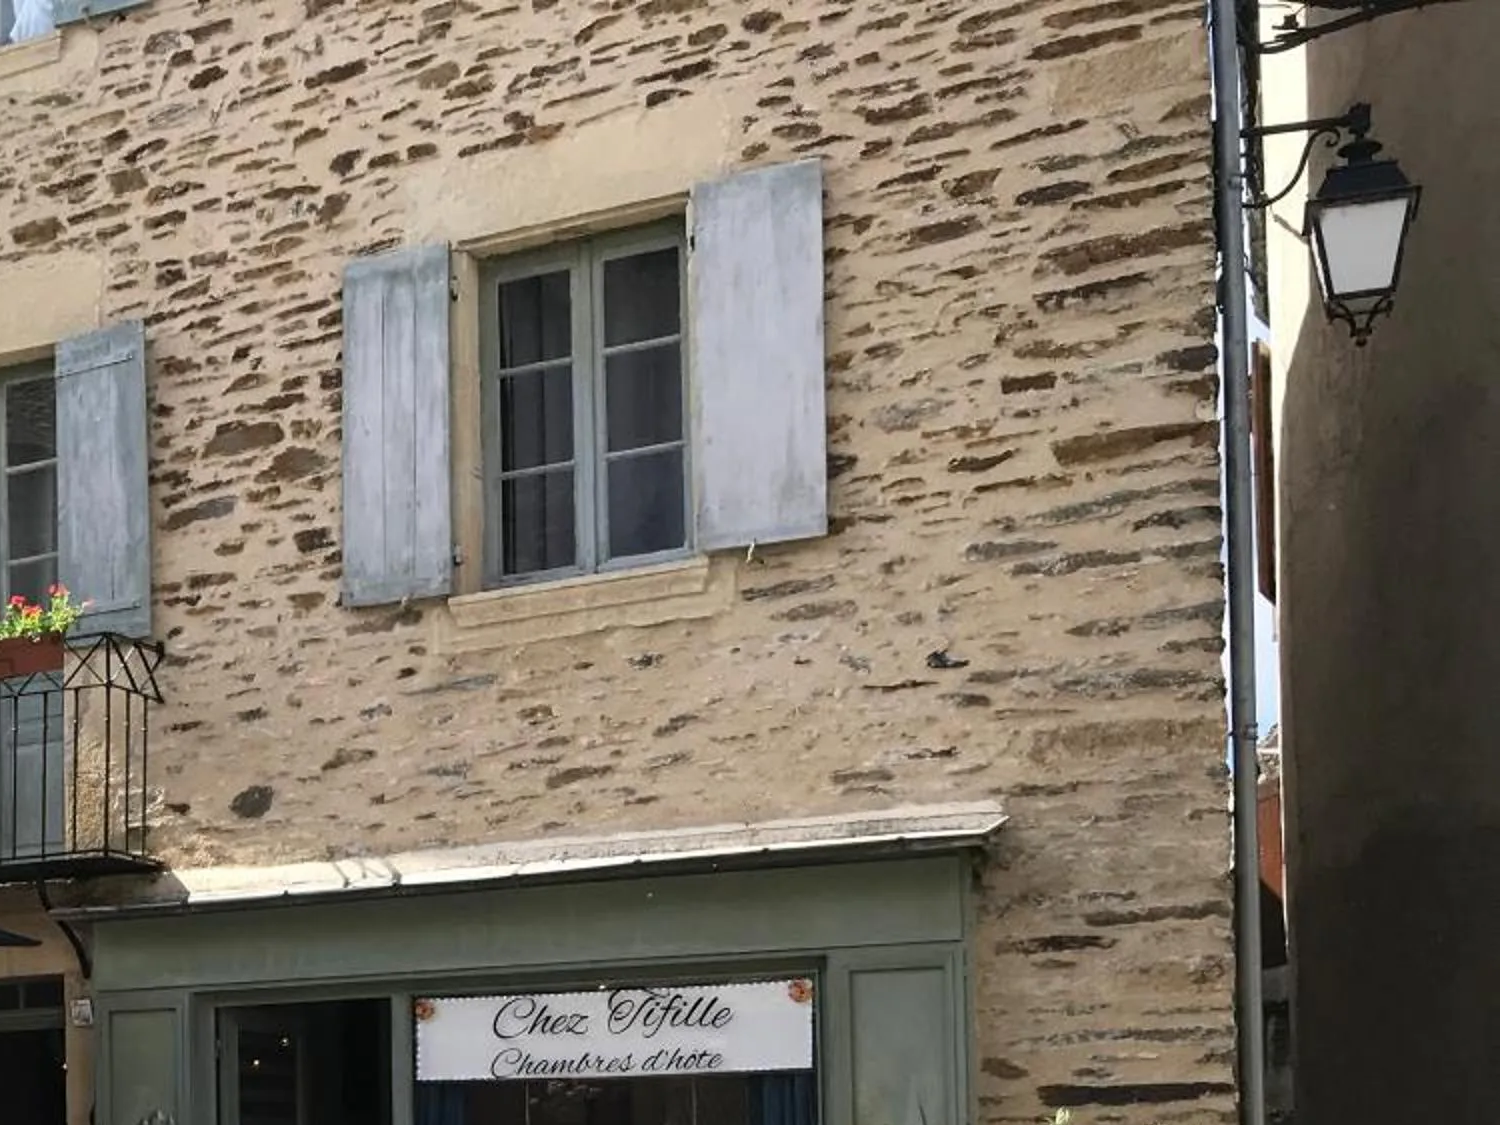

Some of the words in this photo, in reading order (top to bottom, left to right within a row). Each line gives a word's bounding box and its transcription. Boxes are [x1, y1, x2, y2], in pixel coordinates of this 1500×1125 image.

[493, 997, 589, 1039] Chez
[607, 986, 733, 1039] Tifille
[491, 1048, 632, 1079] Chambres
[641, 1047, 724, 1073] d'hôte
